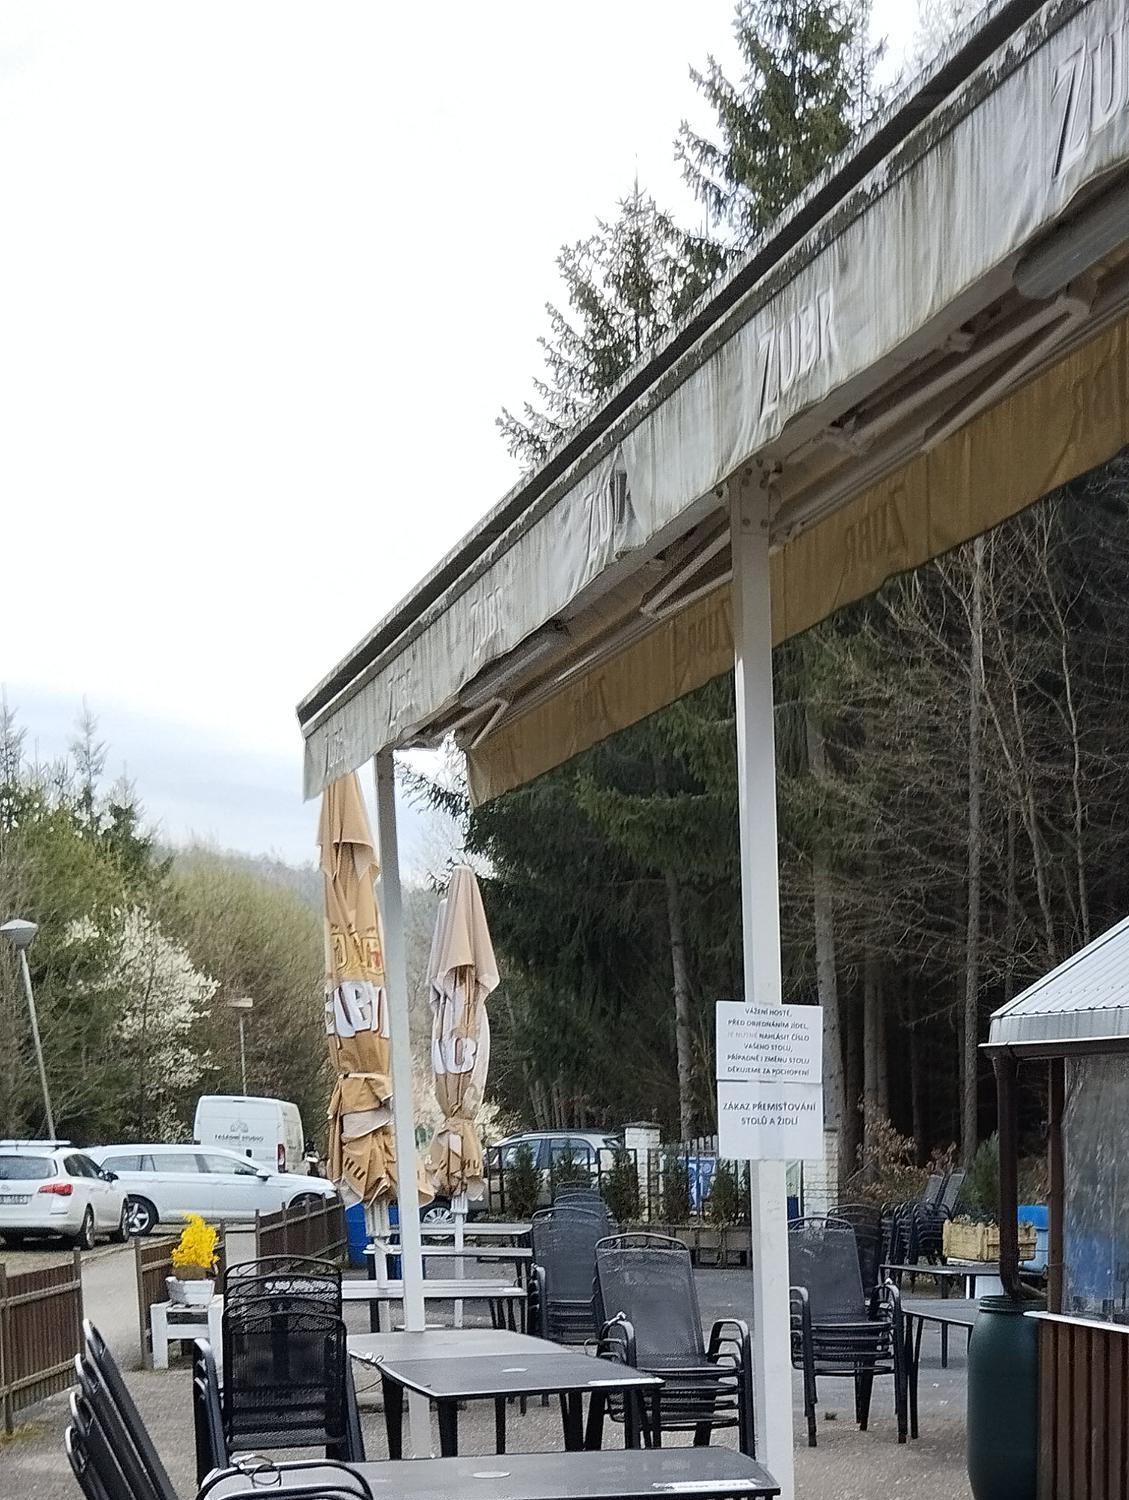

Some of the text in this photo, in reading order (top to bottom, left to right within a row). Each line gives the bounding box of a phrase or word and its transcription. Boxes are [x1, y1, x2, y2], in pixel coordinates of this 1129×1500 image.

[723, 1102, 751, 1111] ZÁKAZ
[741, 1113, 799, 1126] STOLŮ A ŽIDLÍ
